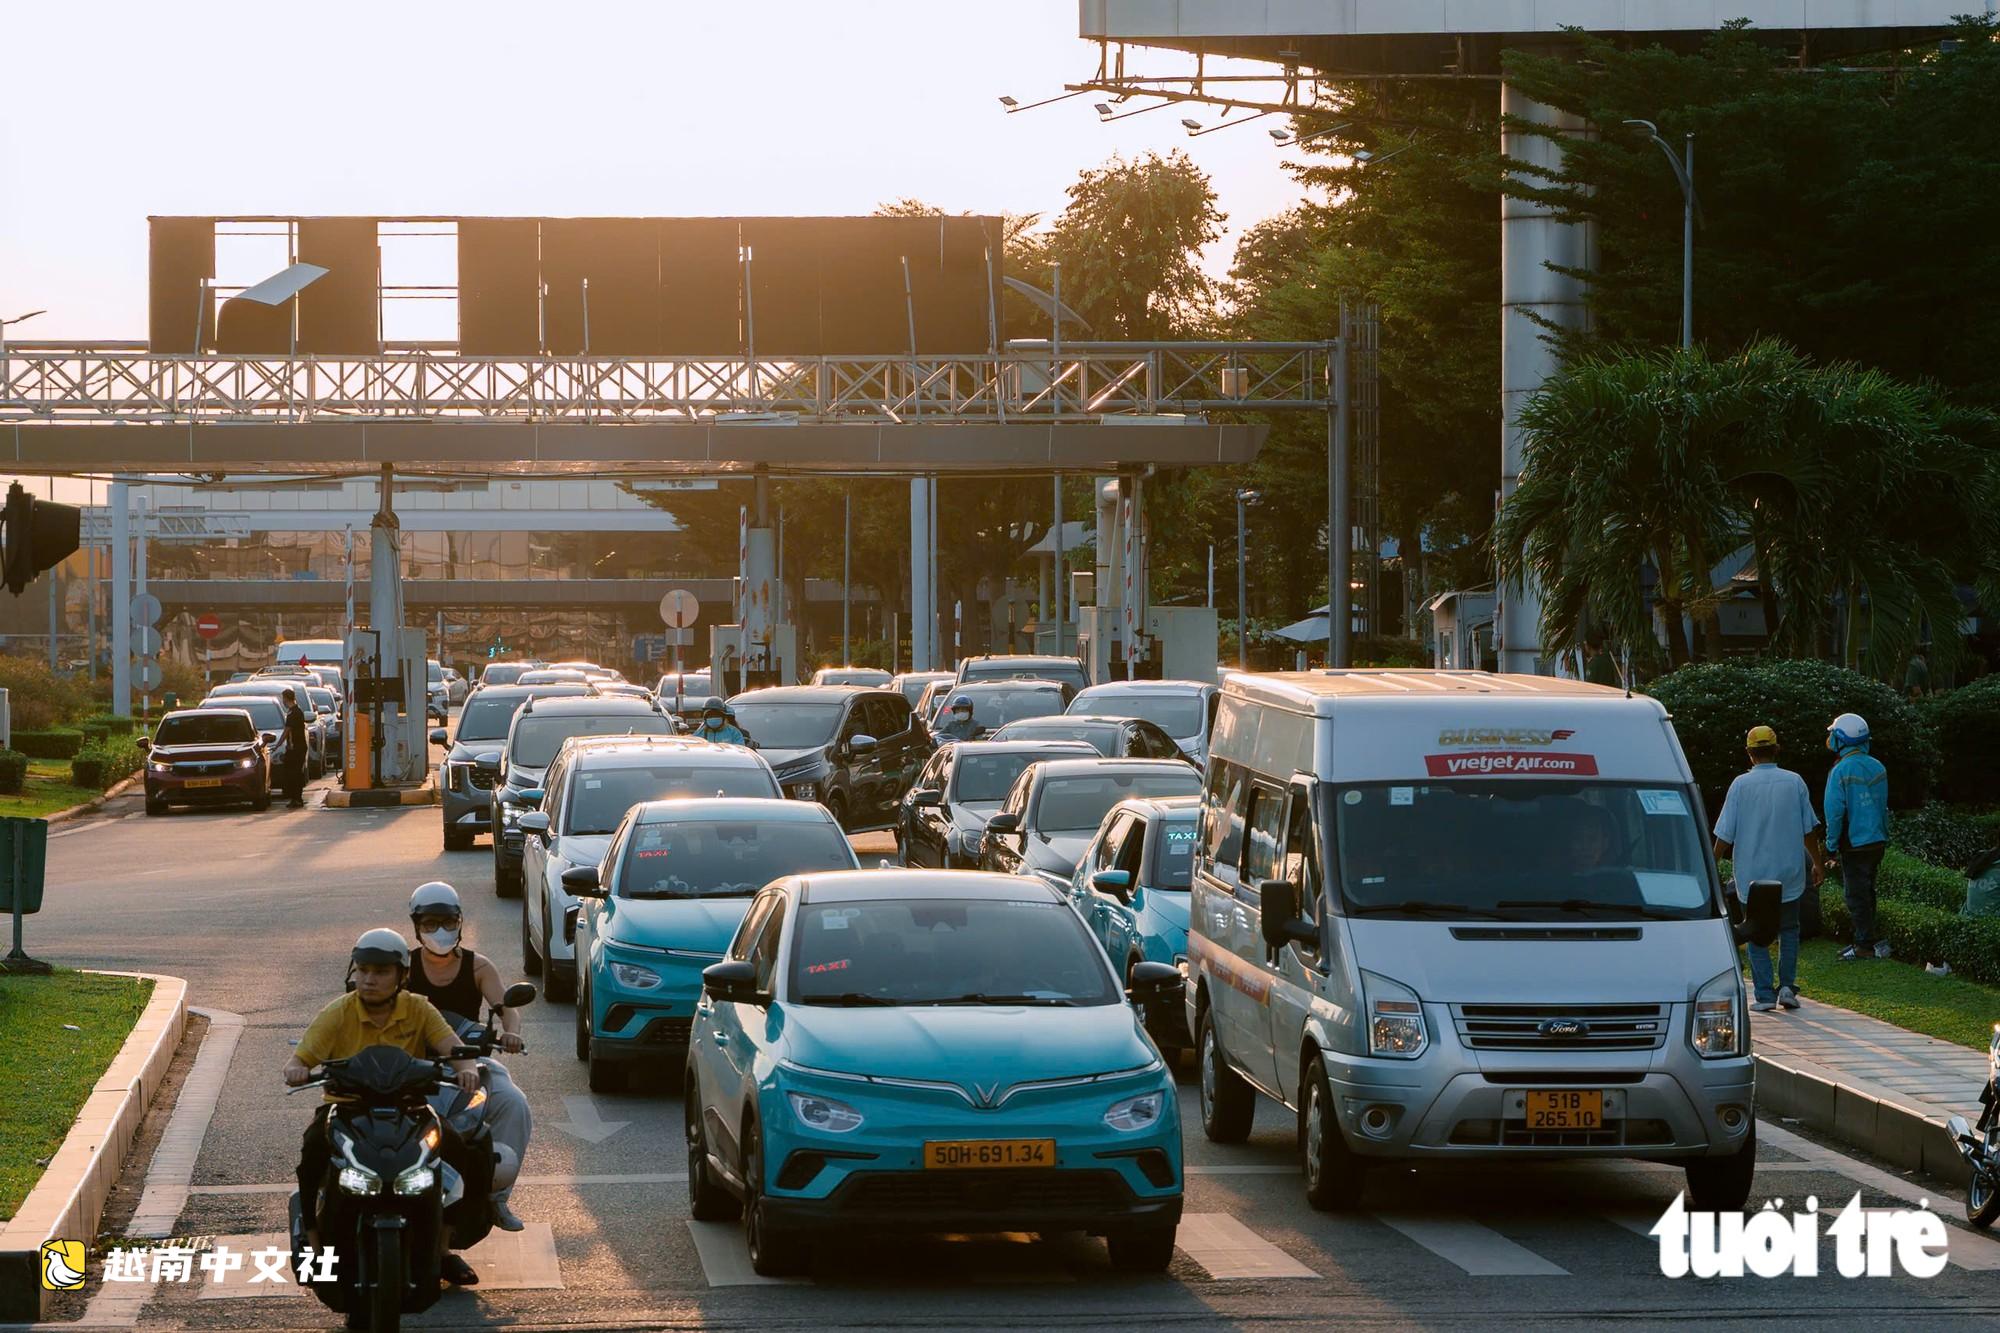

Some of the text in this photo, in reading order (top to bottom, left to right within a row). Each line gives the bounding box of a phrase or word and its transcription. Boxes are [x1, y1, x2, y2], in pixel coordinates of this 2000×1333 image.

[1439, 728, 1552, 746] BUSINESS
[1168, 832, 1197, 840] TAXI
[639, 849, 669, 858] TAXI
[808, 959, 848, 974] TAXI
[1550, 1020, 1579, 1034] Ford
[1548, 1093, 1580, 1109] 51B
[1535, 1111, 1595, 1127] 265.10
[935, 1144, 1045, 1164] 50H-691.34
